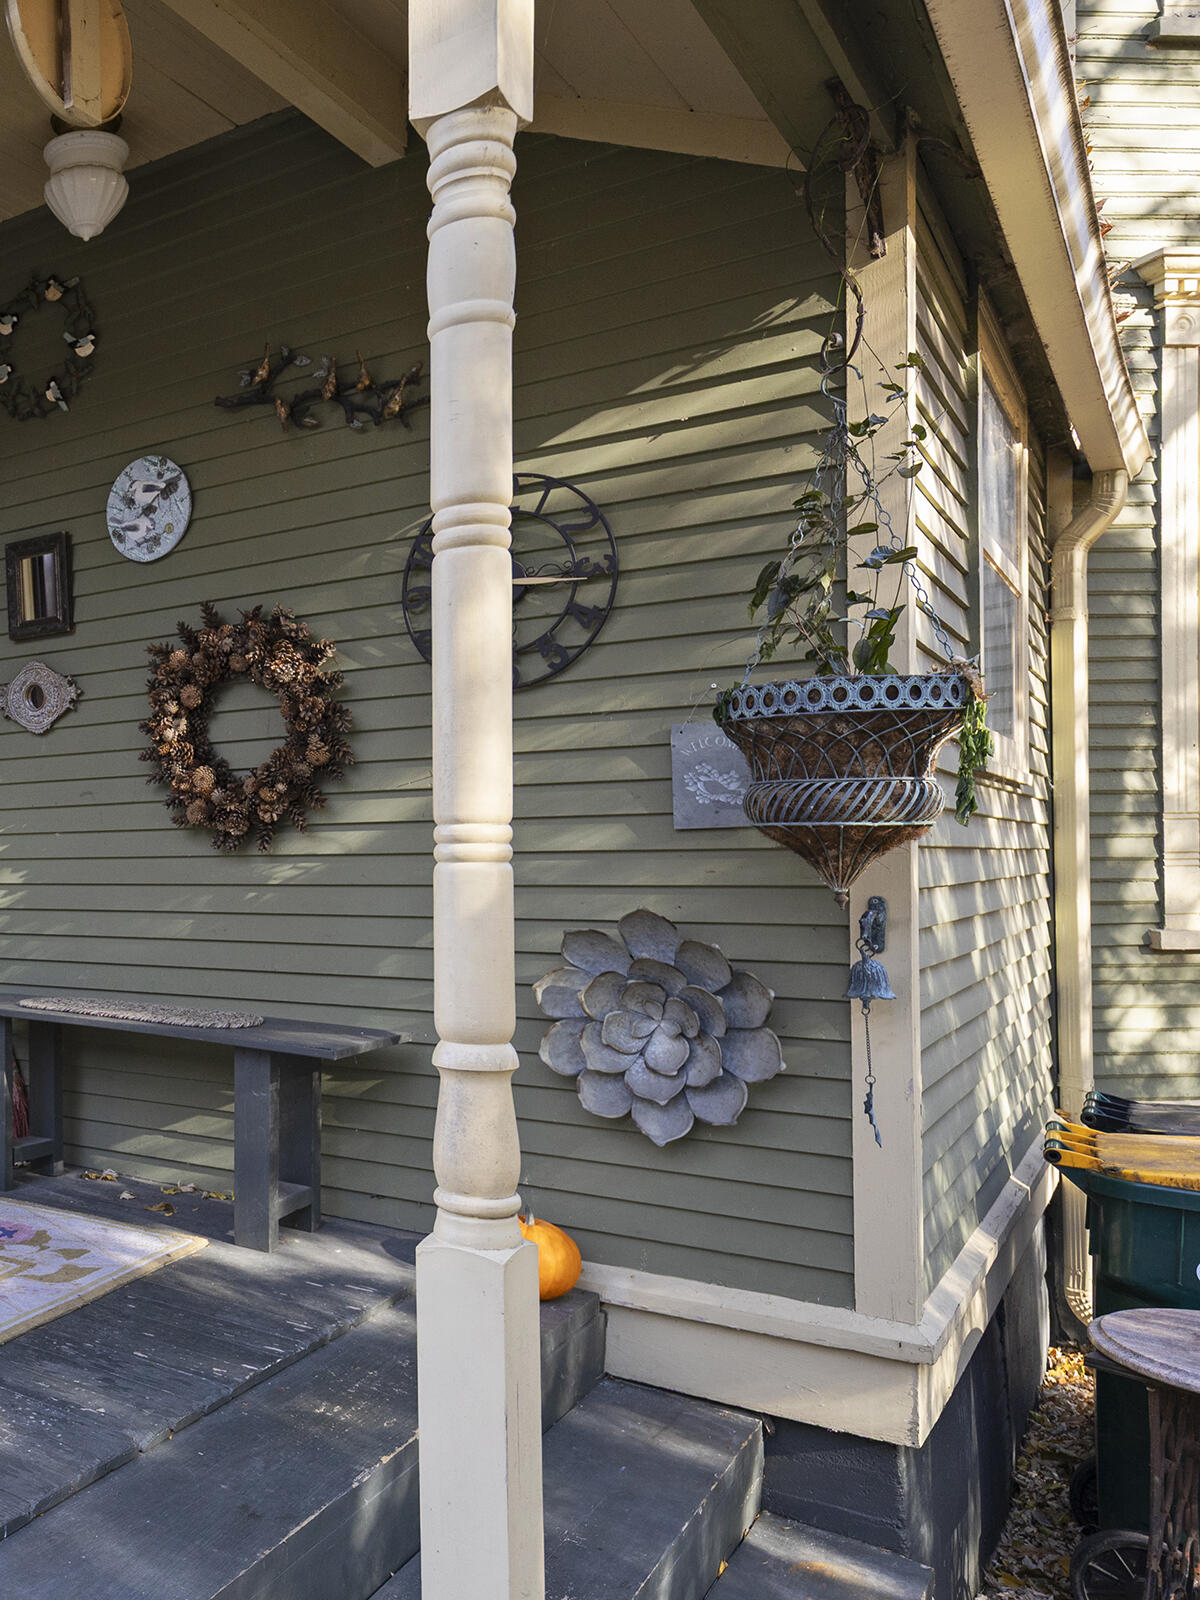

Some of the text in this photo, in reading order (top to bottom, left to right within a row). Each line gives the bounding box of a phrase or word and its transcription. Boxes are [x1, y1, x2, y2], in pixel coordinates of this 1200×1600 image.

[568, 601, 606, 629] 4
[536, 632, 570, 672] 5
[680, 735, 740, 757] WELCOM
